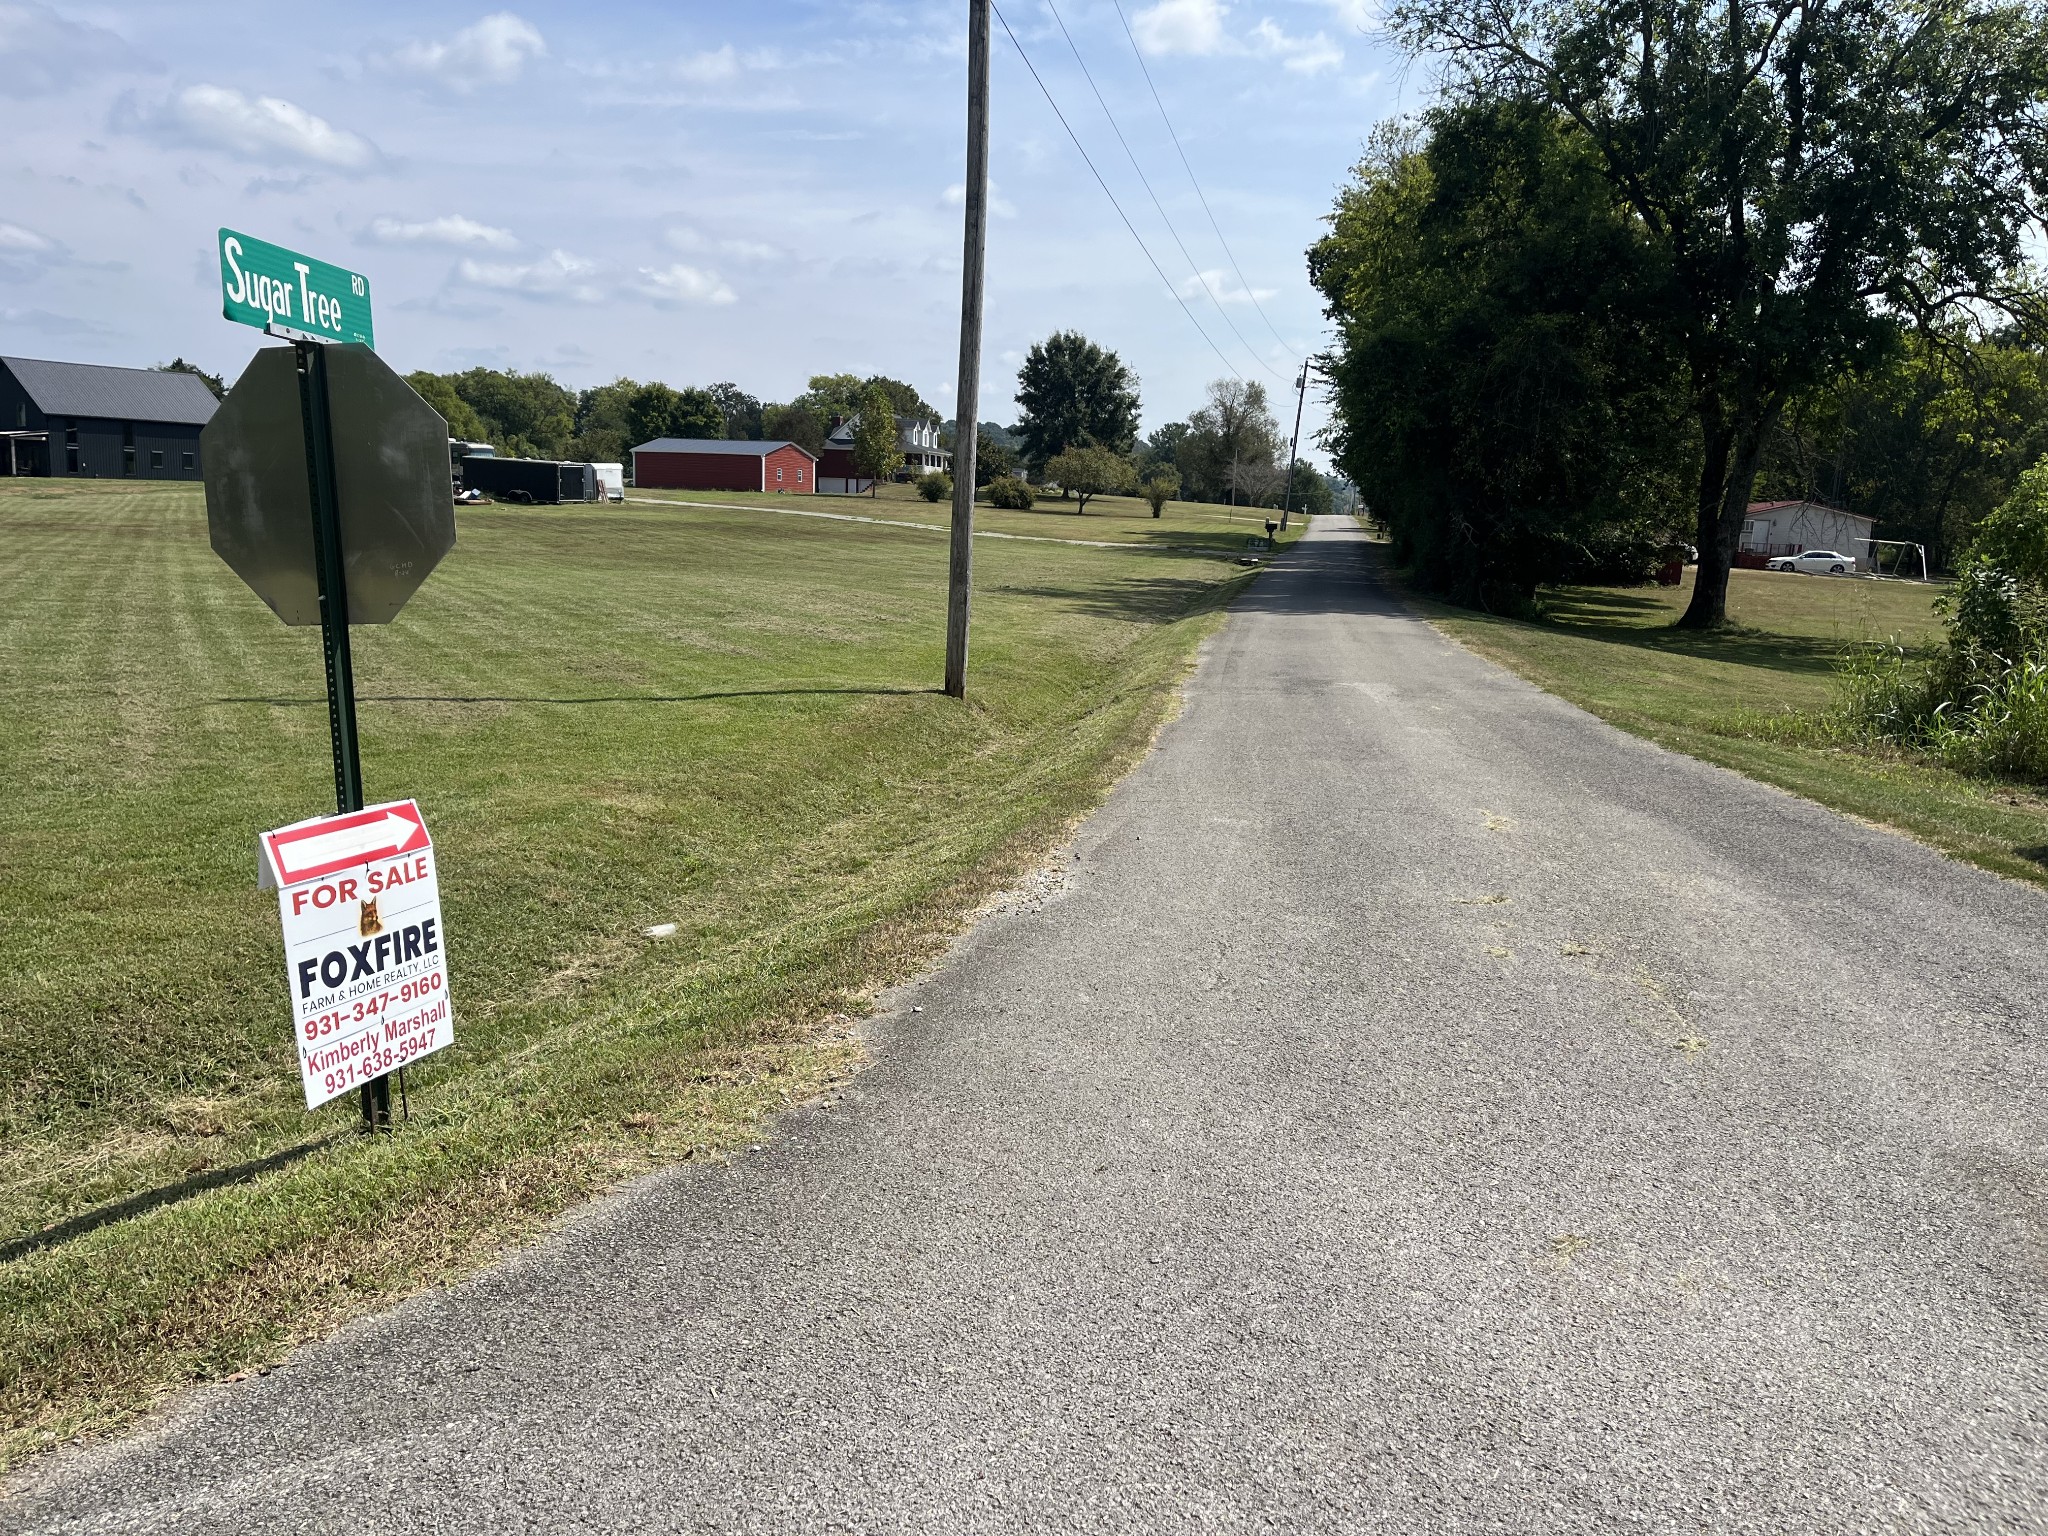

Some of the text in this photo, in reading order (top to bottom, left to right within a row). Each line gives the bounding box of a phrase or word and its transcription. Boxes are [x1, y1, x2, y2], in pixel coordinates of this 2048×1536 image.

[224, 236, 342, 332] Sugar Tree
[351, 274, 365, 297] RD
[292, 856, 429, 916] FOR SALE
[298, 917, 438, 999] FOXFIRE
[302, 954, 439, 1015] FARM & HOME REALTY, LLC
[304, 972, 442, 1042] 931-347-9160
[308, 999, 447, 1077] Kimberly Marshall
[325, 1028, 436, 1095] 931-638-5947
